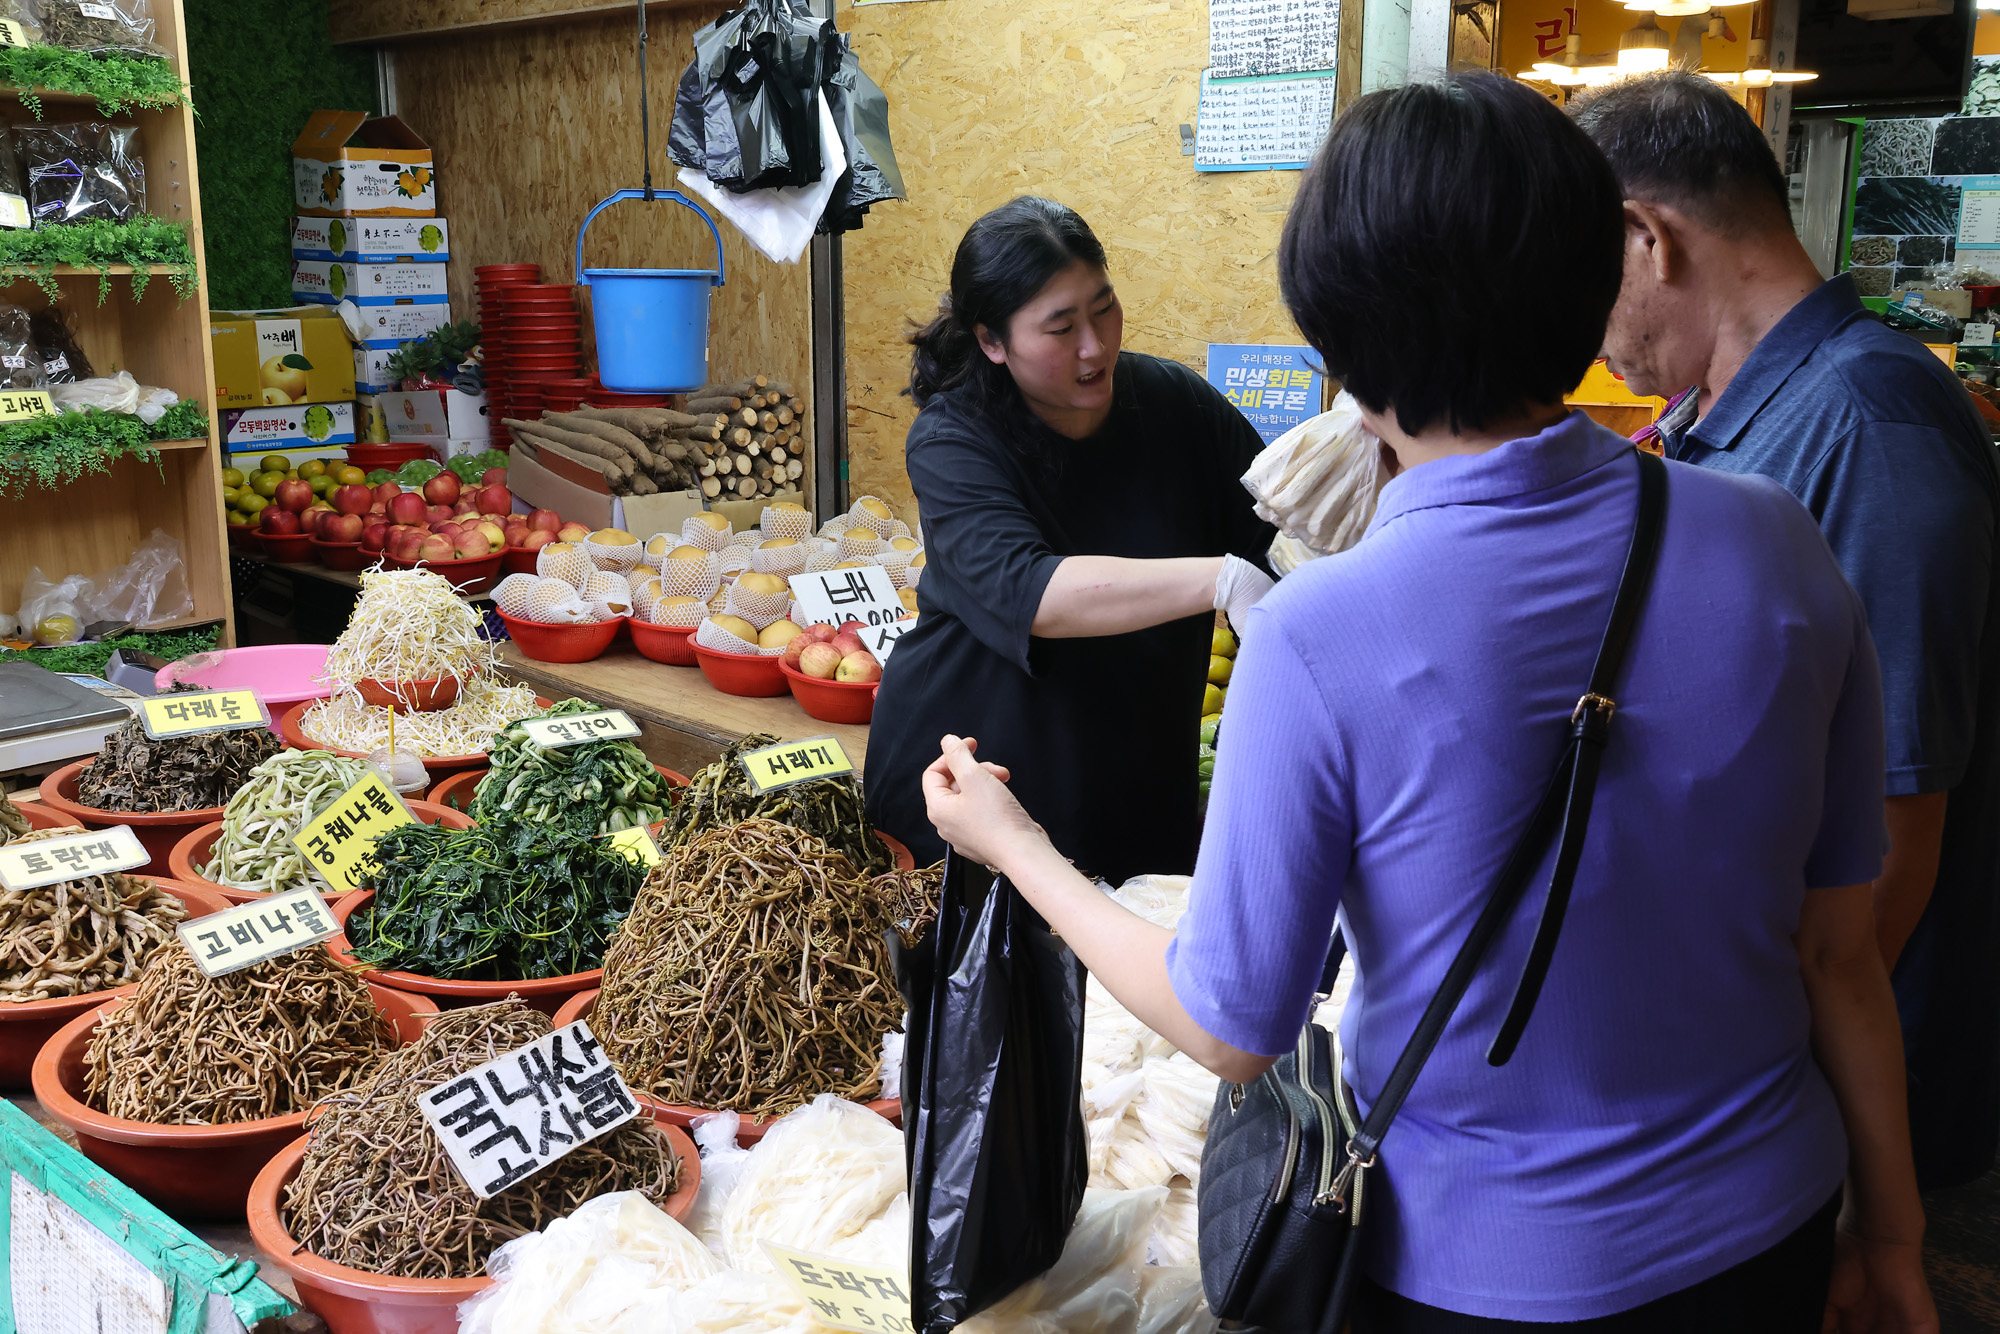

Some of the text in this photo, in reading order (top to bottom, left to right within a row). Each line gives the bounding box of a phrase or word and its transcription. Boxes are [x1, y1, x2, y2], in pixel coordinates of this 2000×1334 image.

[46, 361, 63, 371] 국산
[1240, 354, 1293, 366] 우리 매장은
[1224, 367, 1313, 390] 민생회복
[2, 396, 46, 414] 고사리
[1223, 388, 1308, 411] 소비쿠폰
[239, 419, 287, 433] 모동백화명산
[820, 571, 875, 604] 배
[163, 695, 242, 722] 다래순
[547, 717, 617, 741] 얼갈이
[767, 746, 834, 775] 시래기
[307, 785, 394, 864] 궁채나물
[21, 840, 120, 875] 토란대
[197, 898, 329, 960] 고비나물
[430, 1026, 615, 1138] 국내산
[469, 1067, 635, 1194] 고사리
[788, 1258, 910, 1304] 도라지
